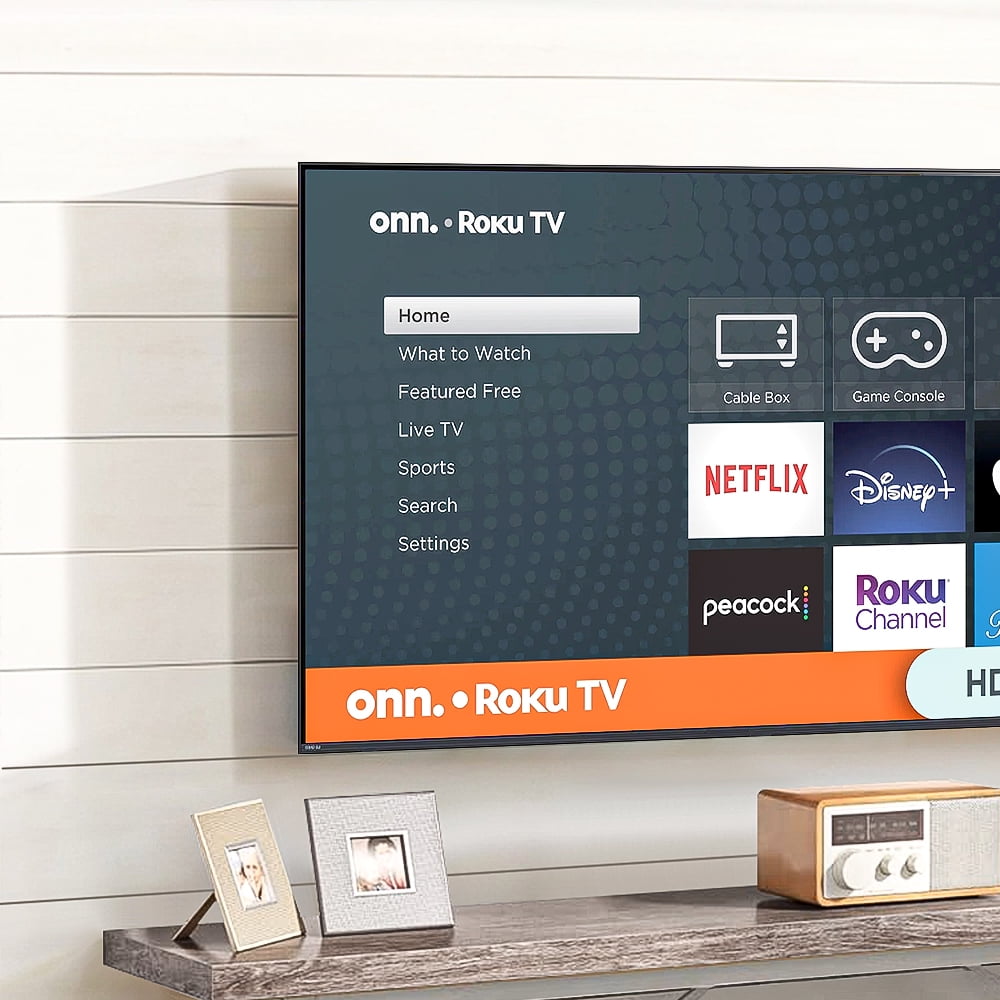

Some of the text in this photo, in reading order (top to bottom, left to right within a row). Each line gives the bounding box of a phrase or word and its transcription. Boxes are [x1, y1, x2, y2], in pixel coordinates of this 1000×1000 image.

[370, 211, 565, 233] onn. Roku TV
[398, 308, 450, 324] Home
[399, 345, 530, 361] What to Watch
[399, 383, 521, 399] Featured Free
[724, 391, 790, 404] Cable Box
[853, 390, 945, 402] Game Console
[399, 422, 463, 437] Live TV
[399, 461, 454, 478] Sports
[706, 464, 807, 496] NETFLIX
[846, 470, 955, 512] Disney+
[399, 497, 457, 513] Search
[399, 536, 469, 553] Settings
[703, 590, 801, 625] peacock
[855, 606, 946, 631] Channel
[347, 679, 626, 719] onn. Roku TV
